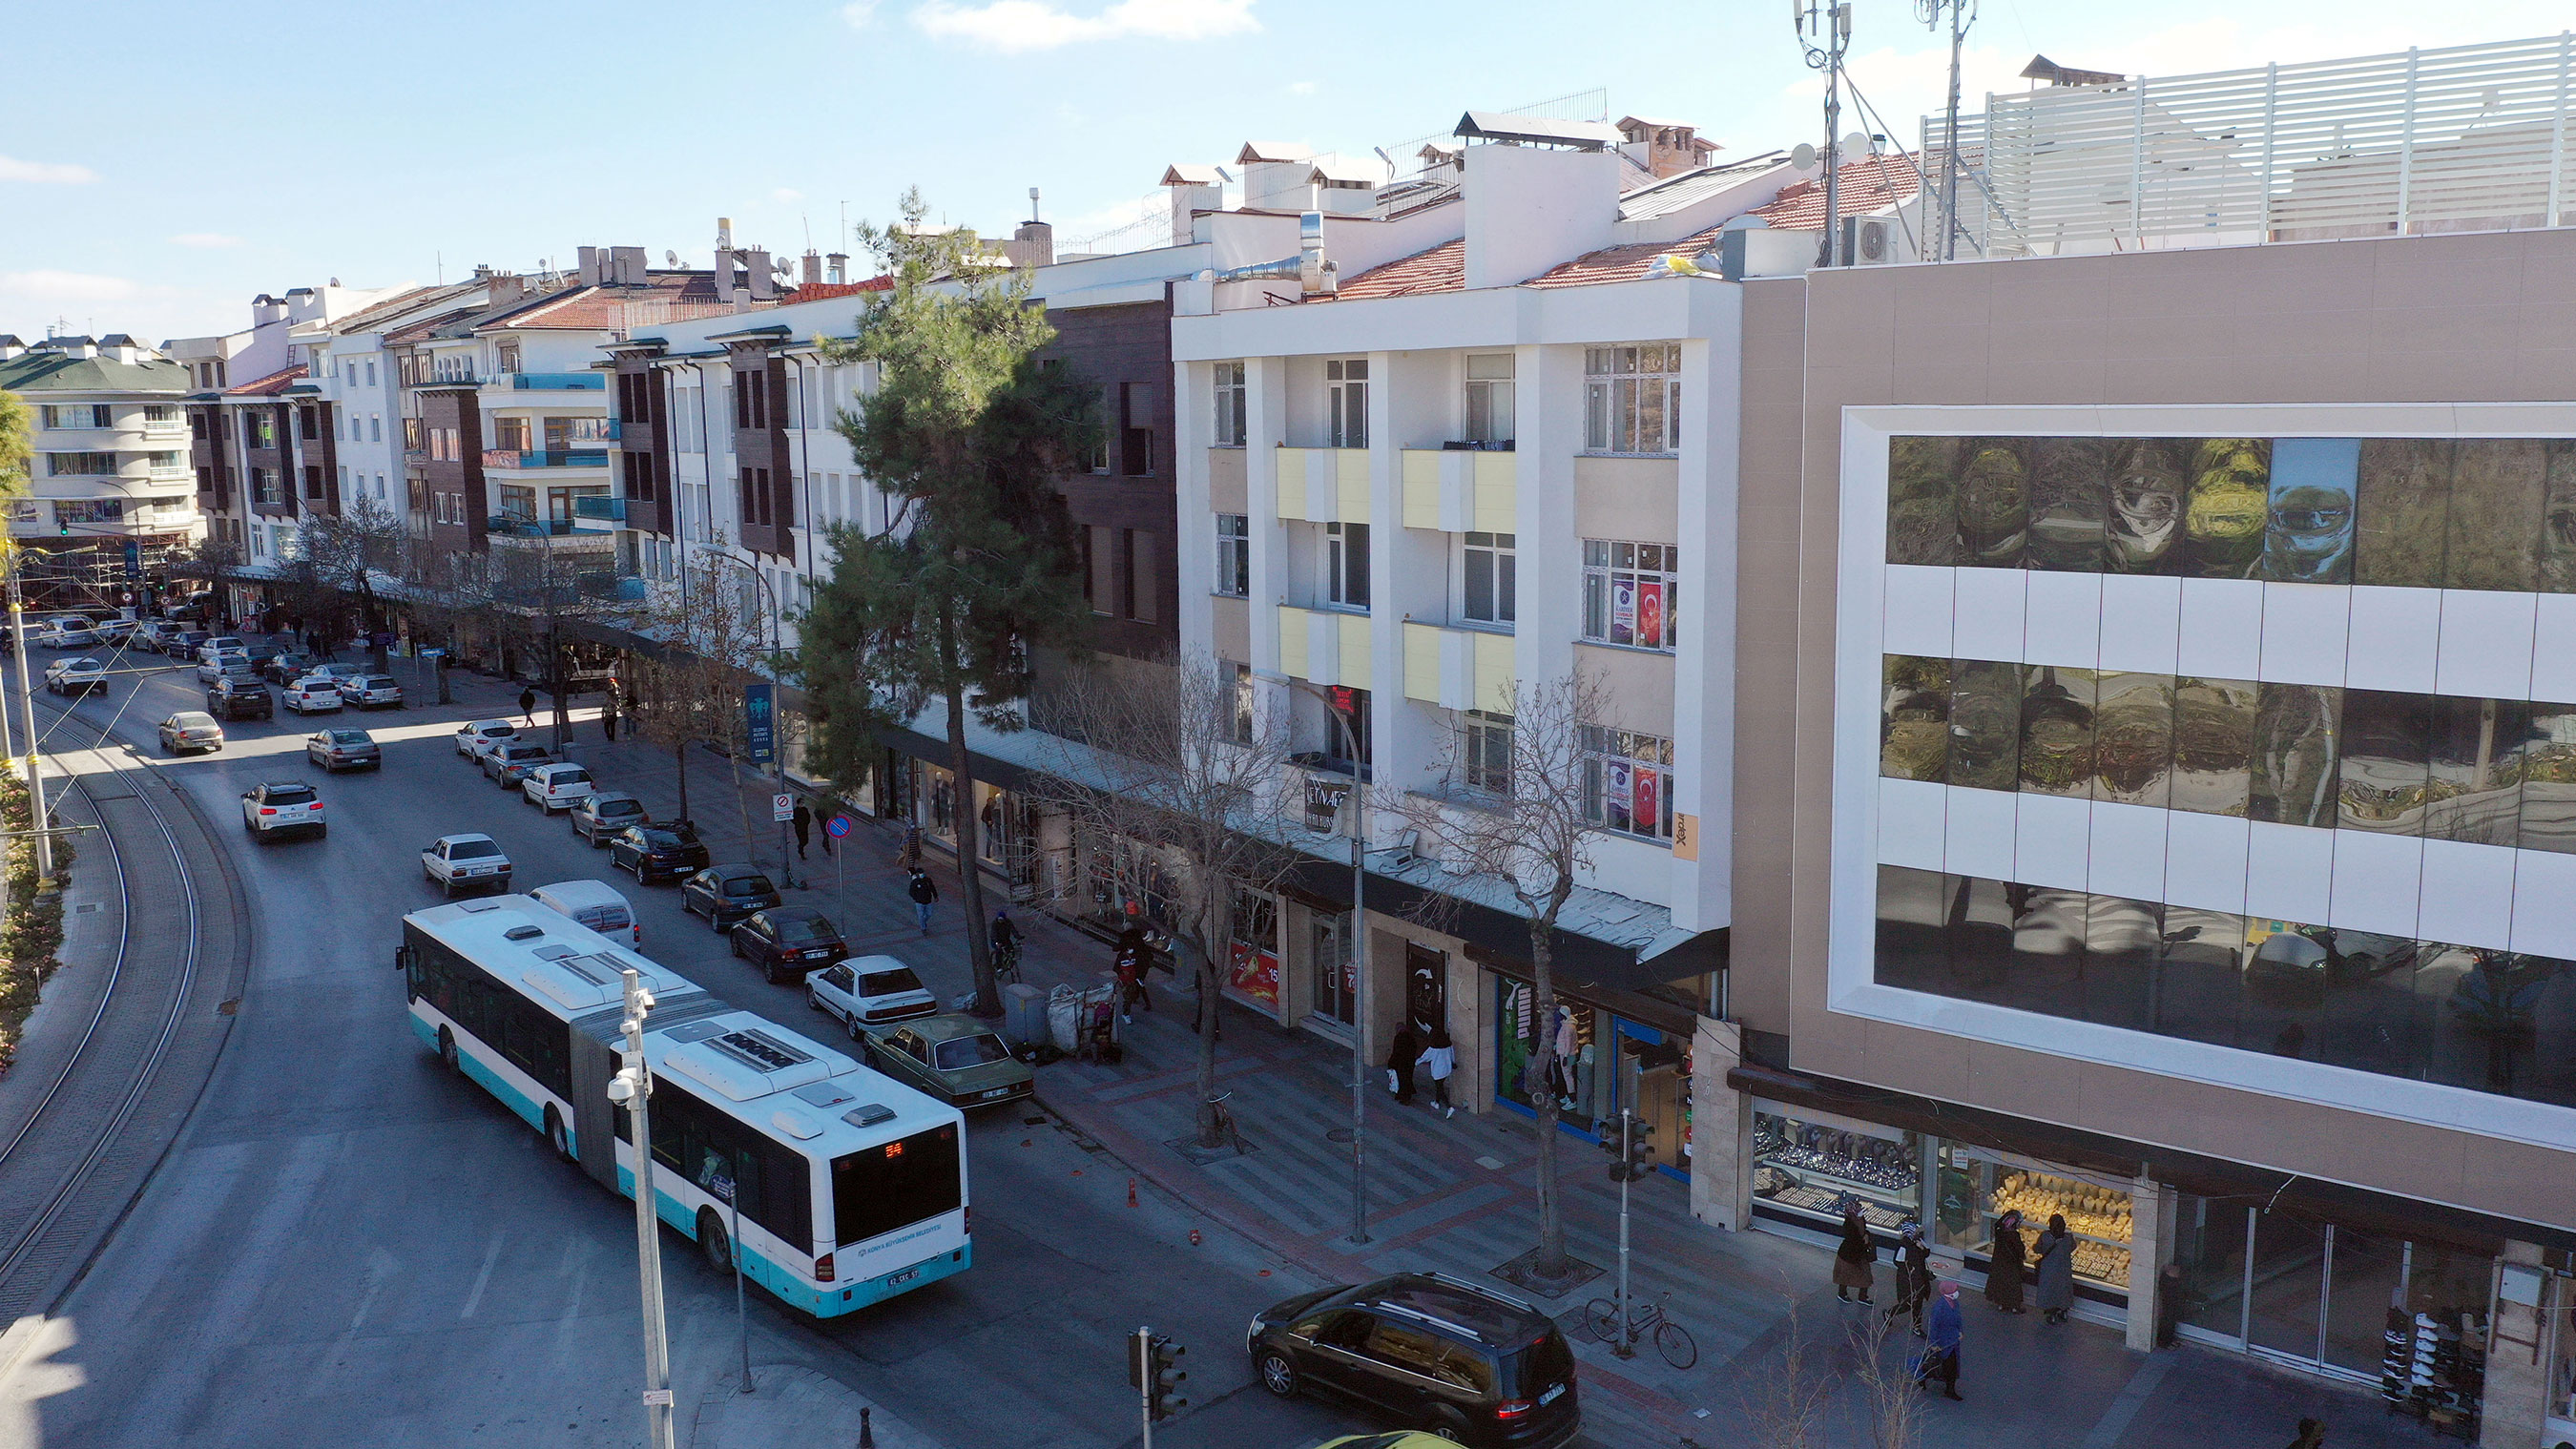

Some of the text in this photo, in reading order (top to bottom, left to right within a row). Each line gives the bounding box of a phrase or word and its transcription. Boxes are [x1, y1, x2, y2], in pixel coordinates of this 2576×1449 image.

[1517, 987, 1531, 1040] PUMA
[867, 1224, 942, 1253] KONYA BÜYÜKŞEHİR BELEDİYESİ
